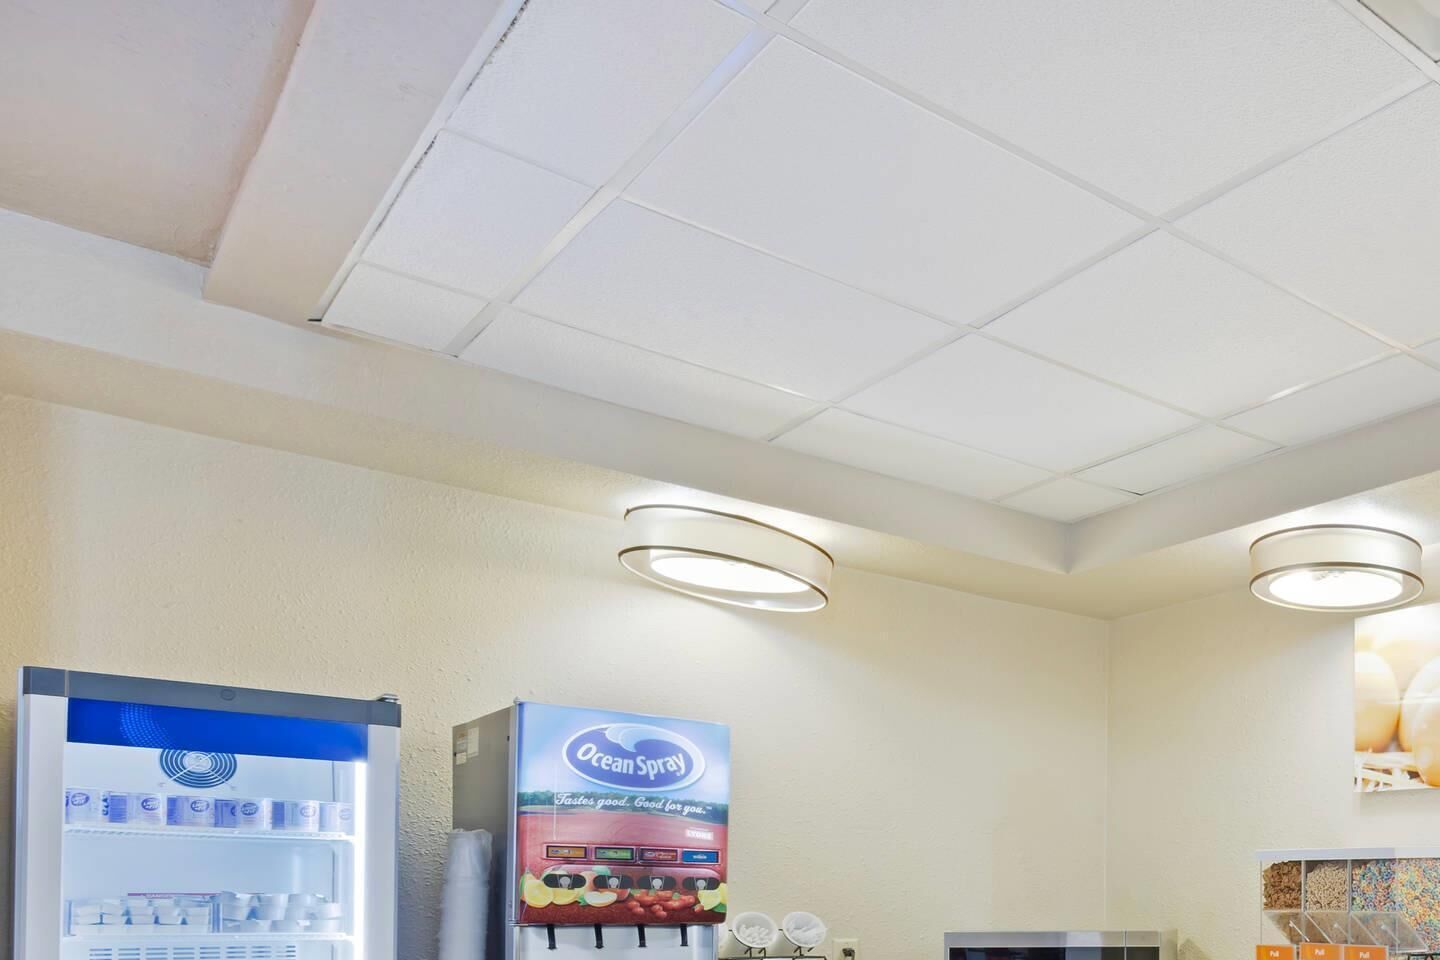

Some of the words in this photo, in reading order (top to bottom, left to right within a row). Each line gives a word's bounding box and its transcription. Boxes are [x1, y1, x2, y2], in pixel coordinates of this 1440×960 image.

[576, 742, 635, 775] Ocean
[636, 752, 687, 781] Spray
[555, 792, 594, 806] Tastes
[595, 796, 630, 810] good.
[634, 796, 664, 809] Good
[663, 799, 683, 812] for
[1315, 948, 1325, 956] Pull
[1359, 951, 1370, 959] Pull
